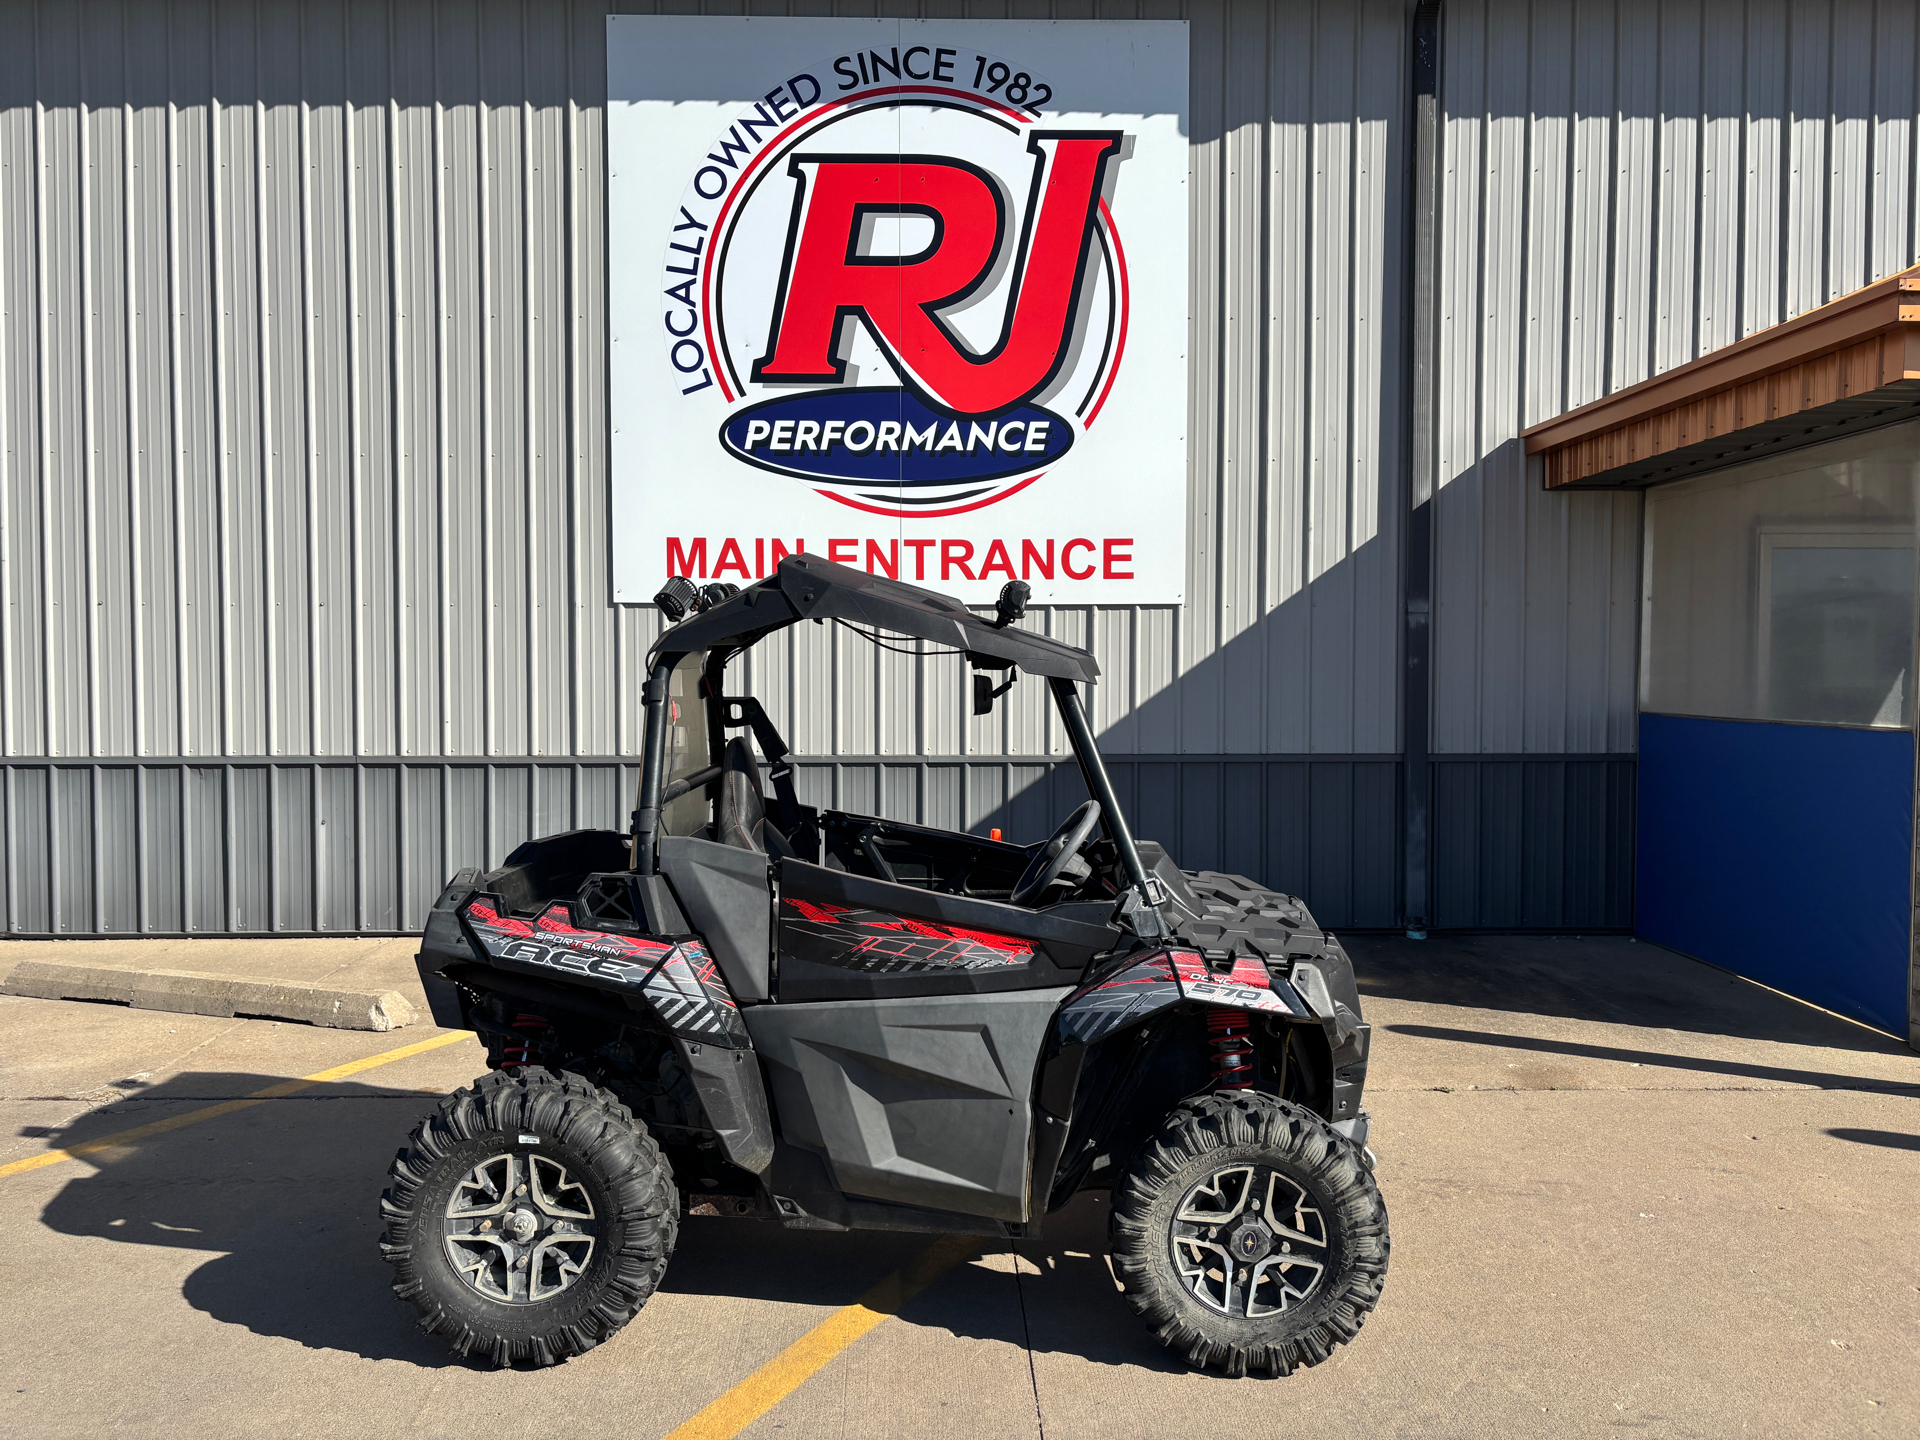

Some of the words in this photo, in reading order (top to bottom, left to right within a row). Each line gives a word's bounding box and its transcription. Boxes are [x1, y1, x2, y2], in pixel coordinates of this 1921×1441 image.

[663, 205, 714, 396] LOCALLY
[693, 73, 822, 200] OWNED
[833, 45, 957, 90] SINCE
[972, 55, 1053, 119] 1982
[750, 129, 1124, 420] RJ
[744, 419, 1050, 452] PERFORMANCE
[828, 537, 1135, 581] ENTRANCE
[500, 940, 641, 983] ACE
[534, 932, 621, 957] SPORTSMAN
[1188, 981, 1262, 1001] 570
